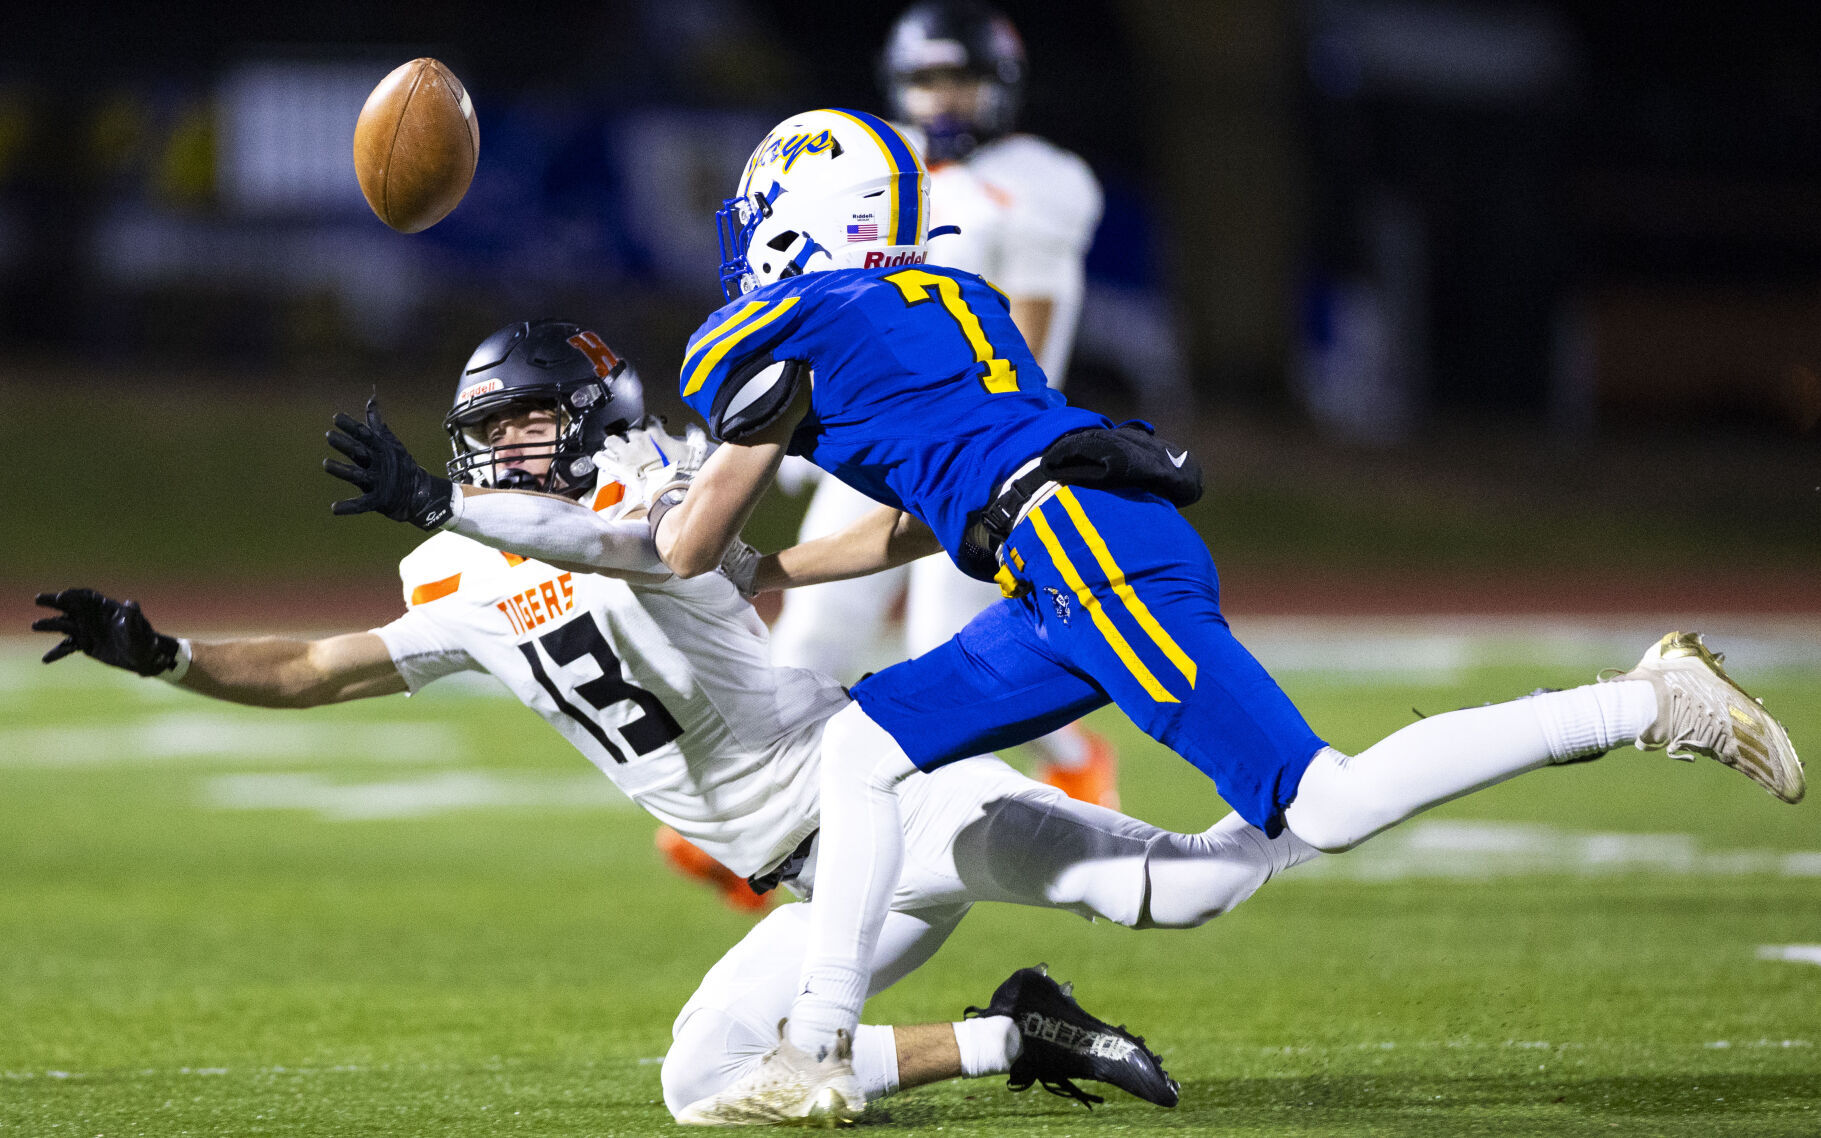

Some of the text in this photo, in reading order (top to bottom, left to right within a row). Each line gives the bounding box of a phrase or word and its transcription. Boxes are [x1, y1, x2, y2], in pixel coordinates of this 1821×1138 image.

[864, 251, 928, 270] Riddell
[876, 268, 1020, 394] 7
[461, 382, 496, 400] Riddell
[496, 571, 574, 636] TIGERS
[517, 610, 685, 764] 13
